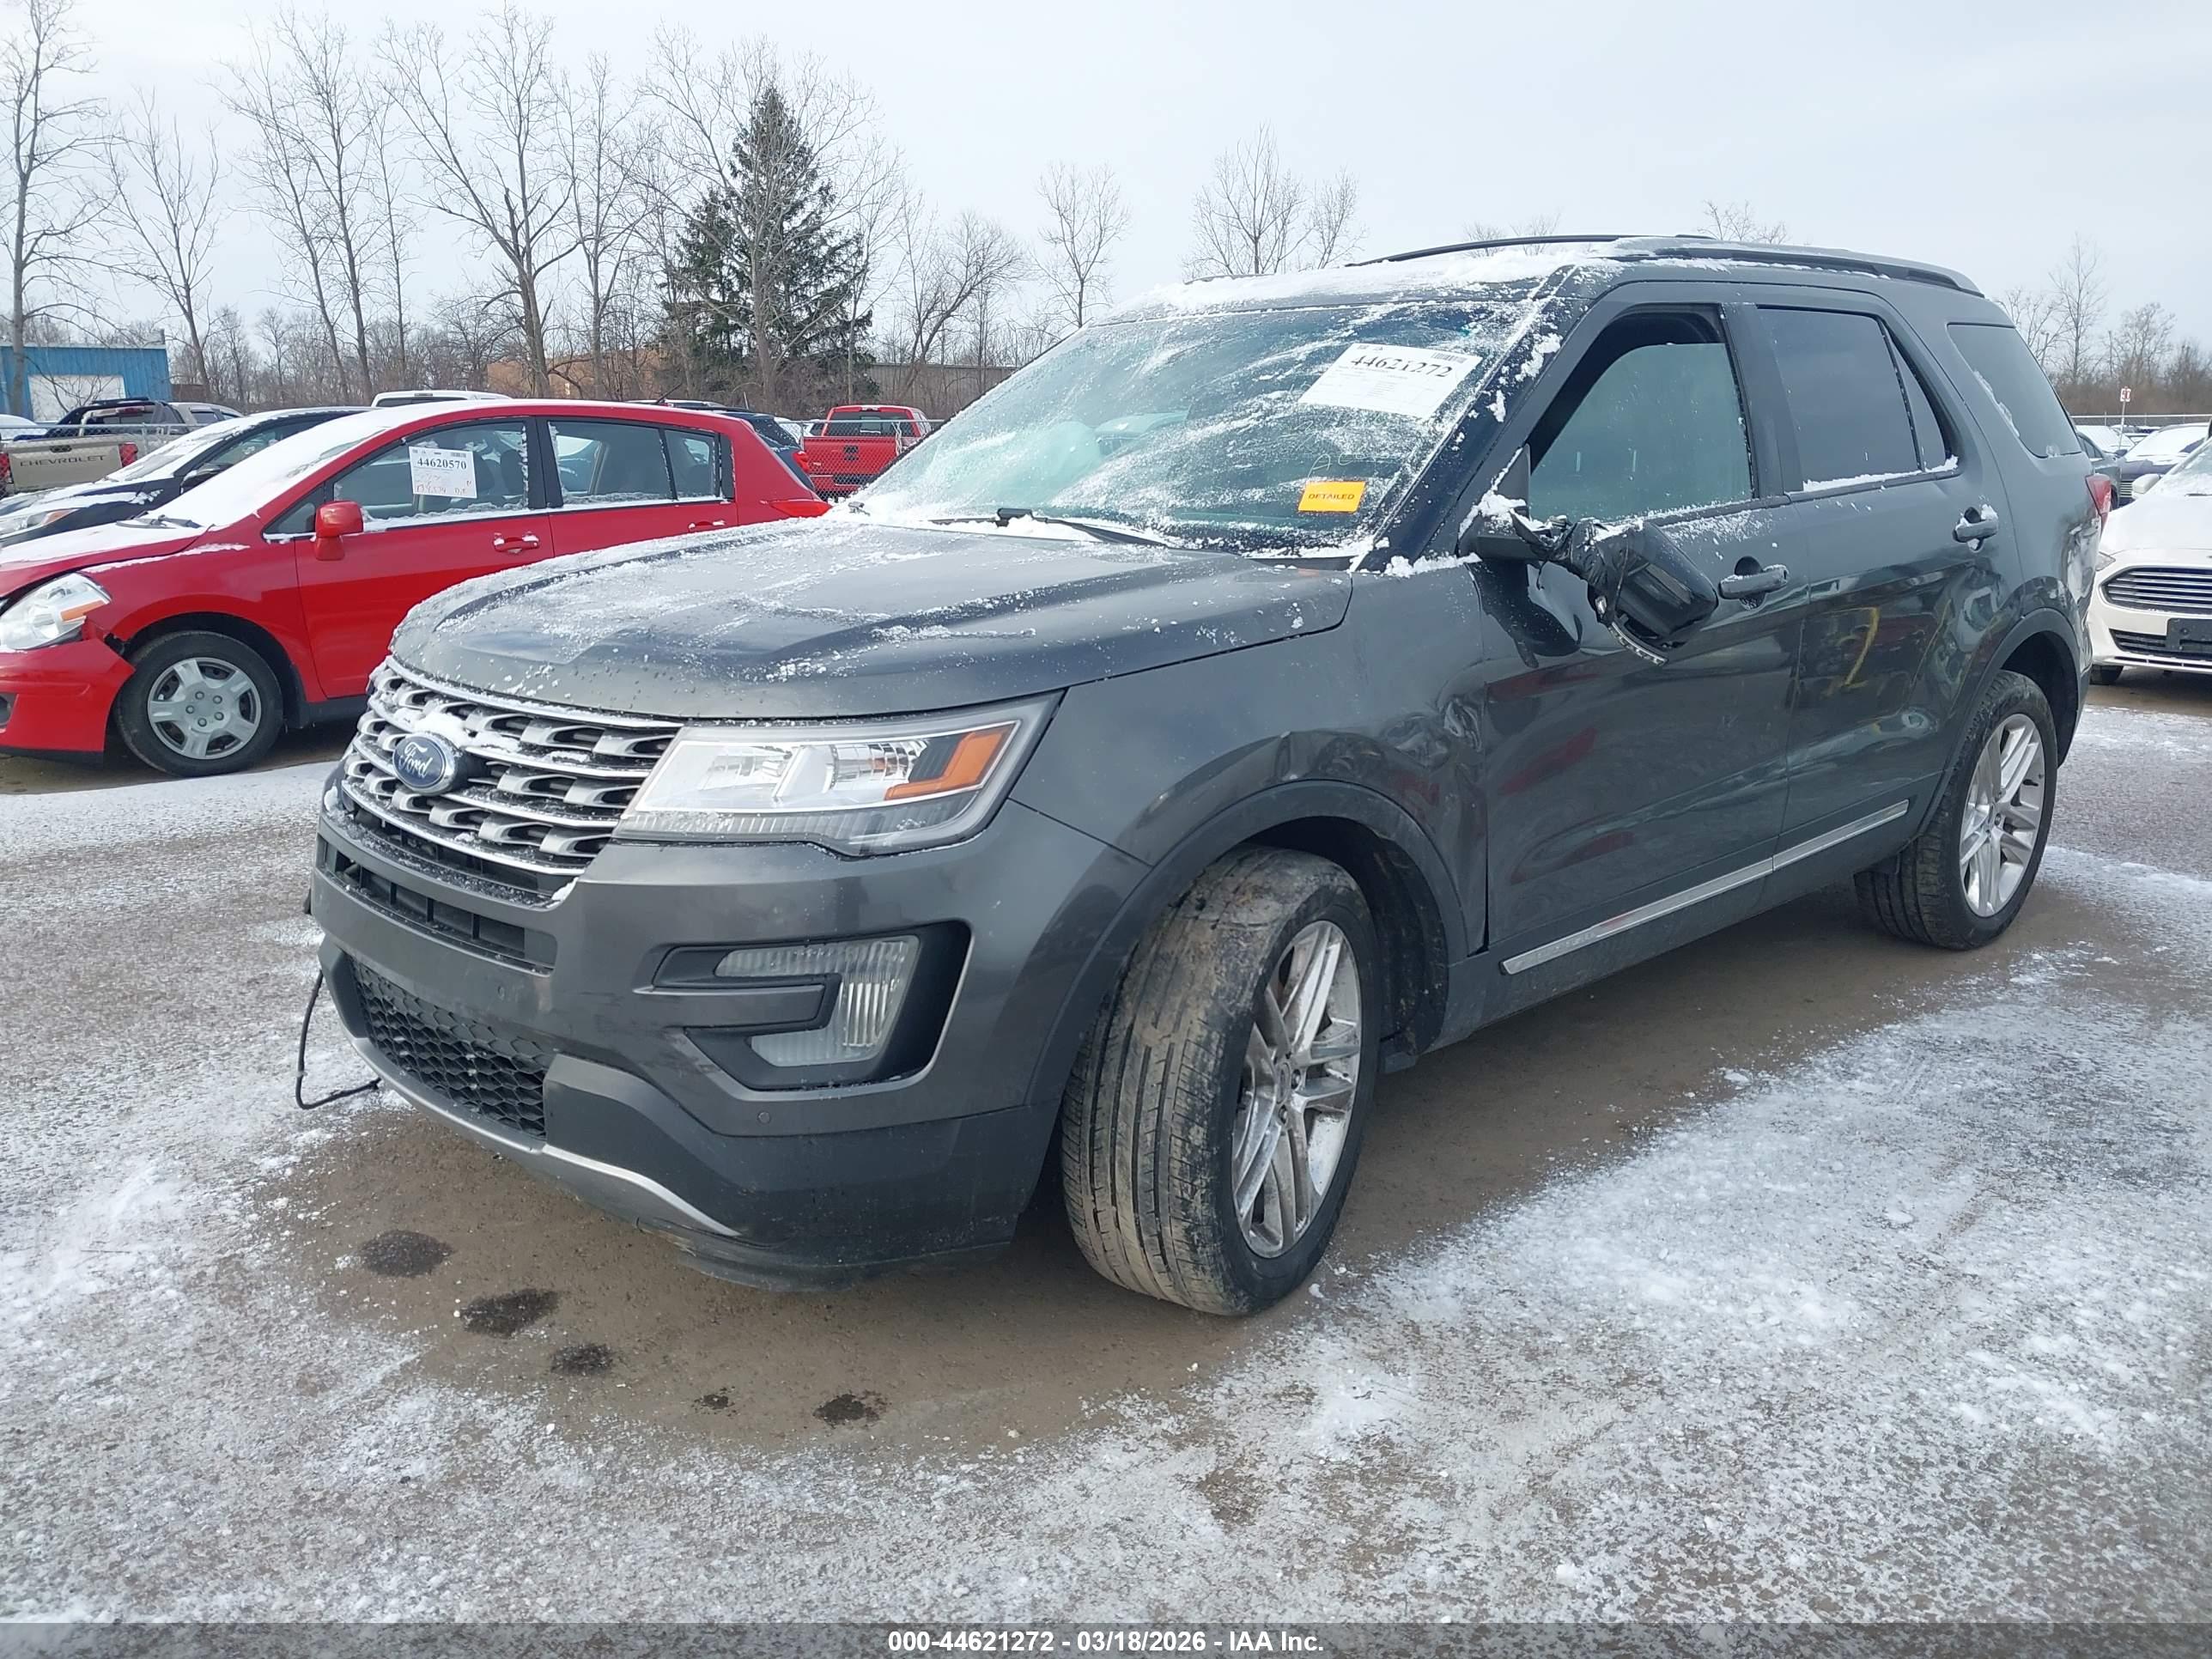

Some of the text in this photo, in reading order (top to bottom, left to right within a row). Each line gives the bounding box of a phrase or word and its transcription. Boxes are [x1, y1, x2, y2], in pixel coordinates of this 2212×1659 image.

[1351, 355, 1453, 378] 44621272
[20, 454, 107, 467] CHEVROLET
[417, 457, 467, 470] 44620570
[398, 741, 434, 779] Ford
